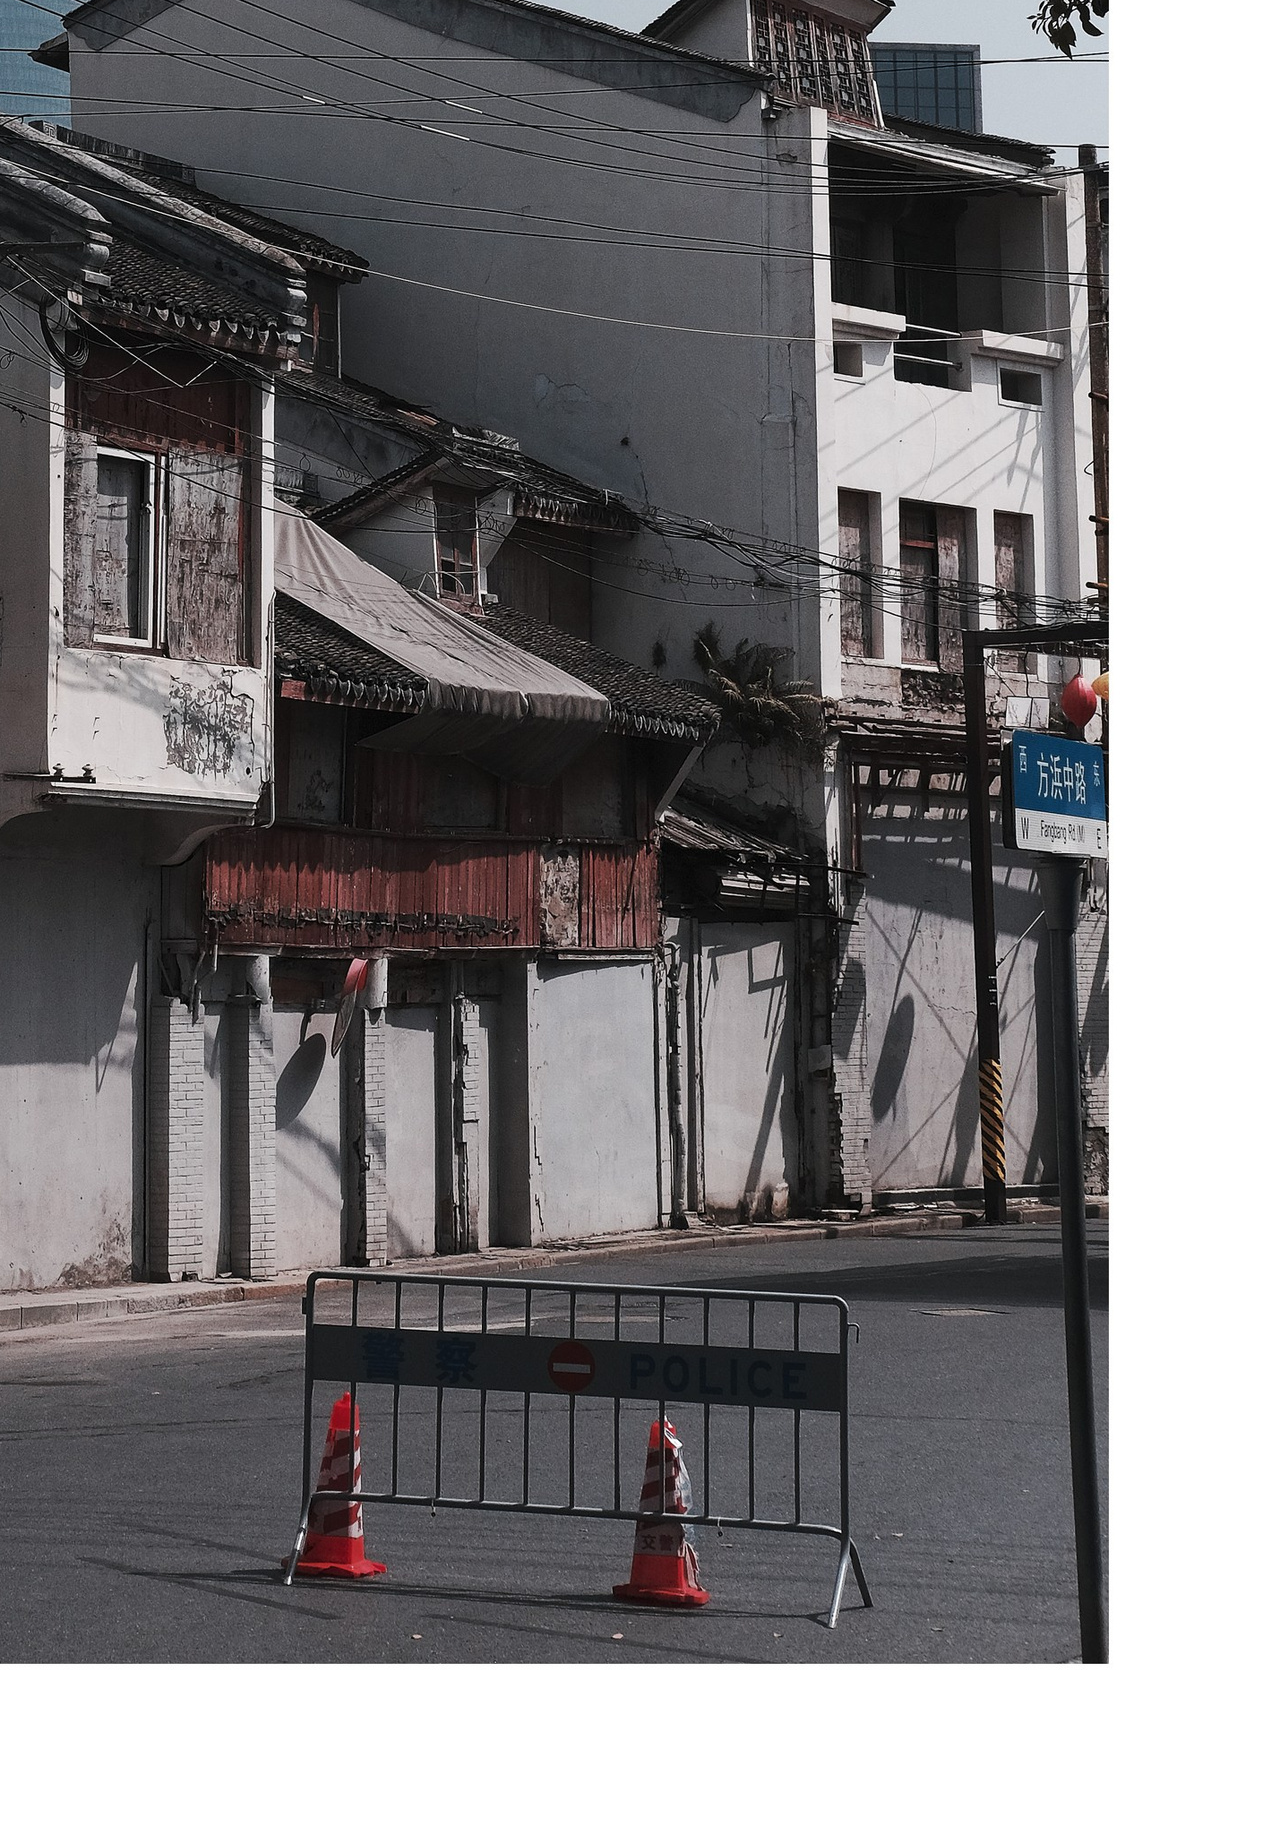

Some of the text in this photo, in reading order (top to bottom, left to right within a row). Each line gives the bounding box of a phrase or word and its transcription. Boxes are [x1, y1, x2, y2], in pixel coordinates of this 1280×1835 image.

[1019, 746, 1101, 805] 西 方浜中路 东
[1021, 817, 1029, 839] W
[1040, 819, 1067, 844] Fangbang
[1068, 823, 1076, 841] Rd
[1096, 827, 1102, 849] E
[361, 1331, 477, 1385] 警察
[630, 1352, 808, 1400] POLICE
[641, 1534, 674, 1552] 交警
